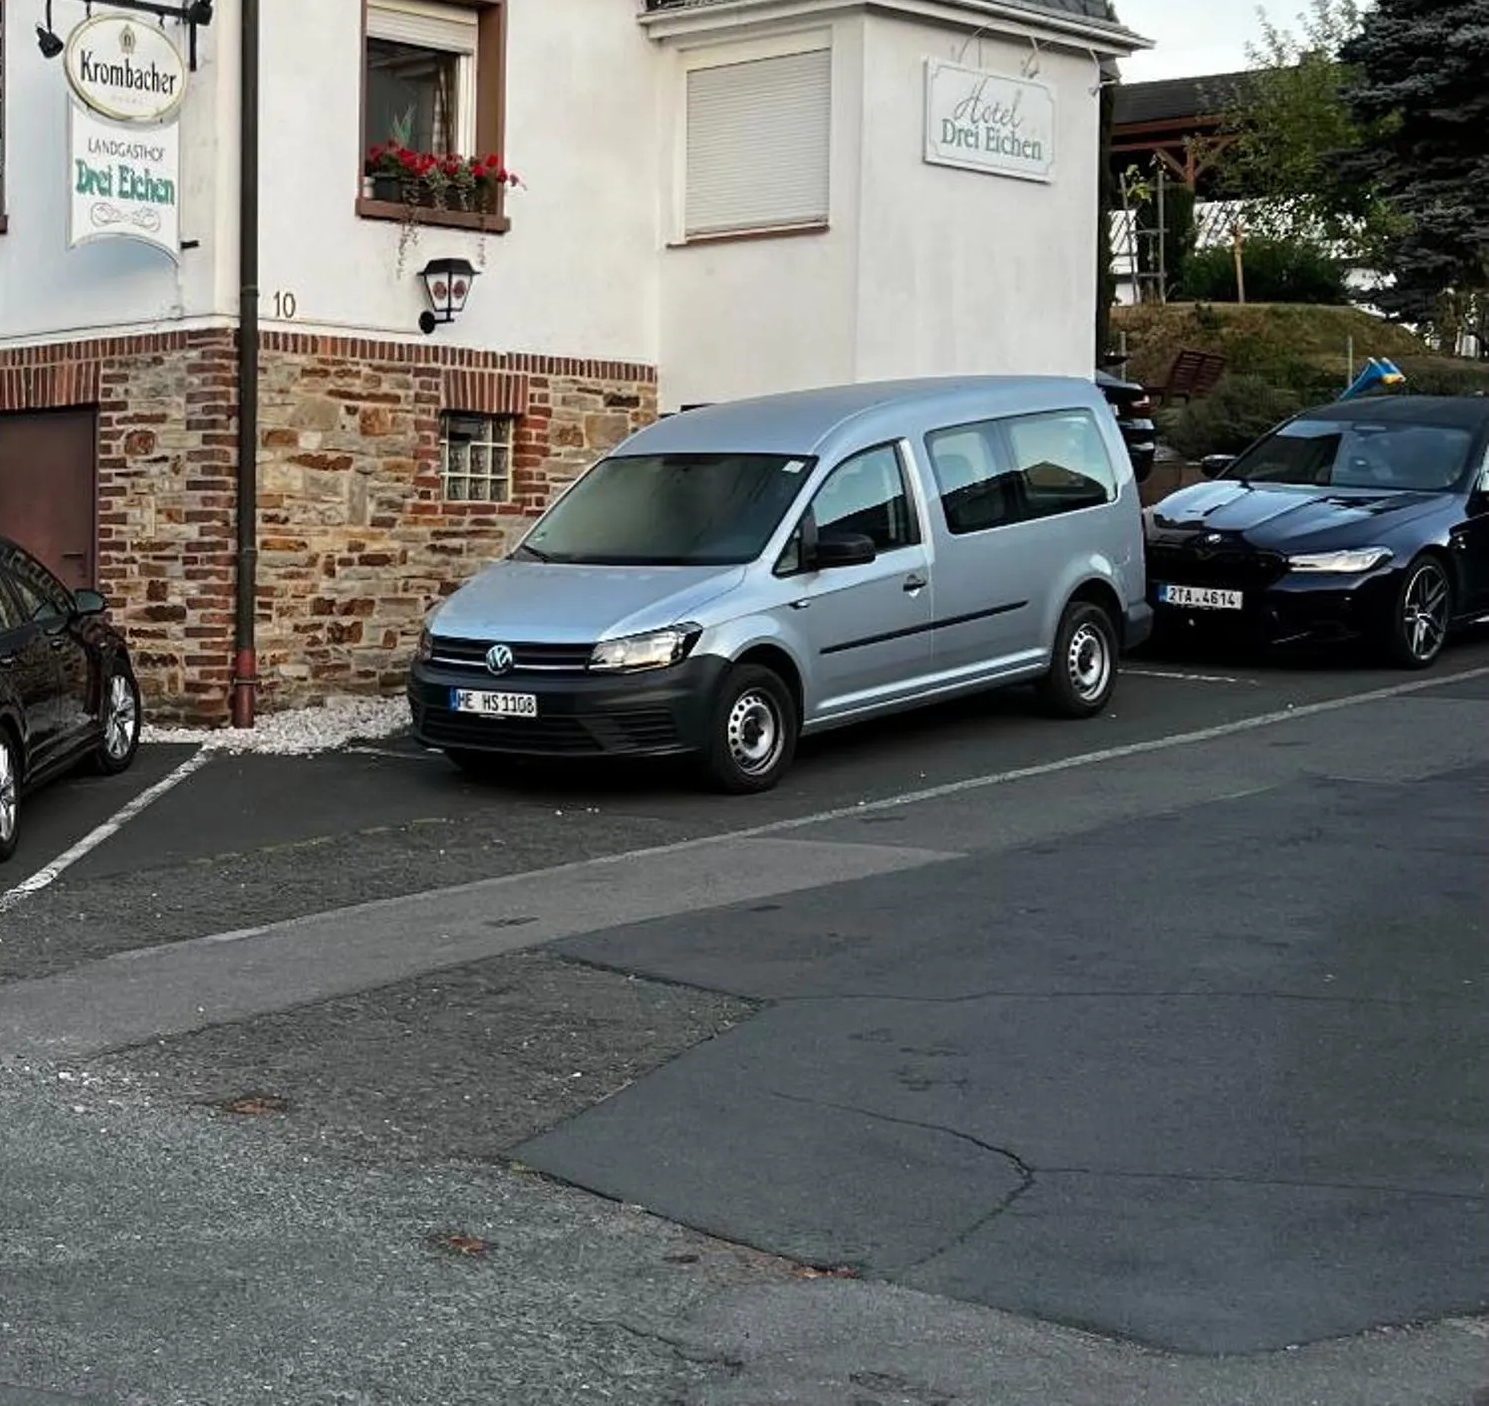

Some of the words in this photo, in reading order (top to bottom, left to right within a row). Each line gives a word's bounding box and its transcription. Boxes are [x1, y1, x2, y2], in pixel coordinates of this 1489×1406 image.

[80, 49, 177, 95] Krombacher
[953, 77, 1024, 128] Hotel
[87, 137, 166, 162] LANDGASTHOF
[941, 118, 980, 149] Drei
[985, 125, 1043, 161] Eichen
[74, 157, 112, 197] Drei
[118, 164, 175, 205] Eichen
[273, 291, 296, 318] 10
